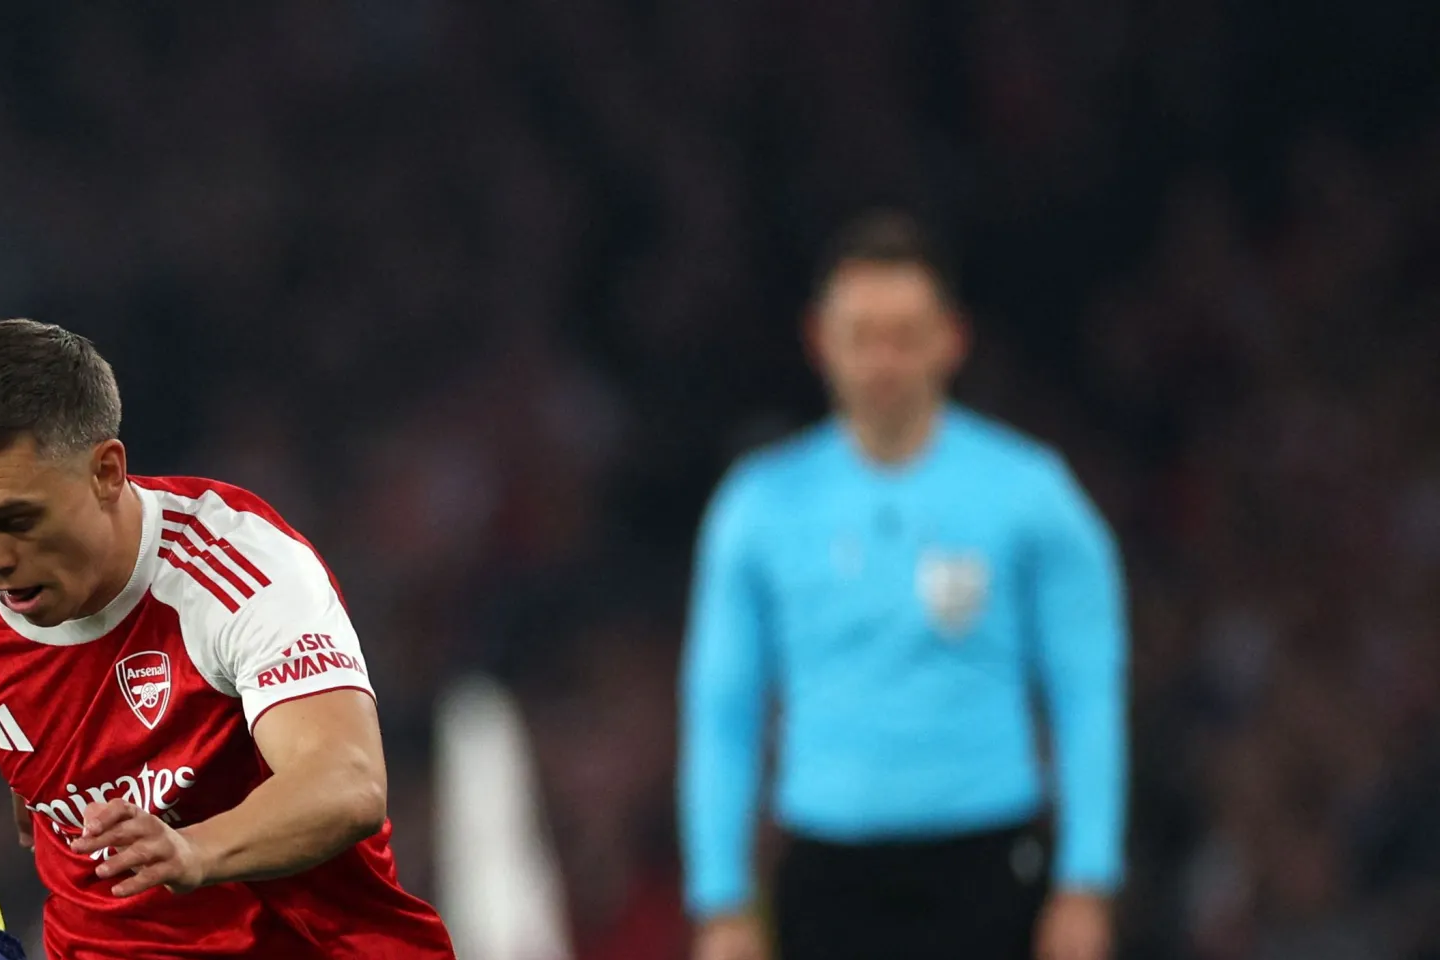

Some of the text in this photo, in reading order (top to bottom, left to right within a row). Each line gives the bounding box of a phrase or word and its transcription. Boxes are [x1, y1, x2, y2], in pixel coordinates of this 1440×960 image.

[282, 633, 336, 657] VISIT
[127, 663, 165, 680] Arsenal
[257, 651, 366, 688] RWANDA
[25, 762, 196, 829] mirates
